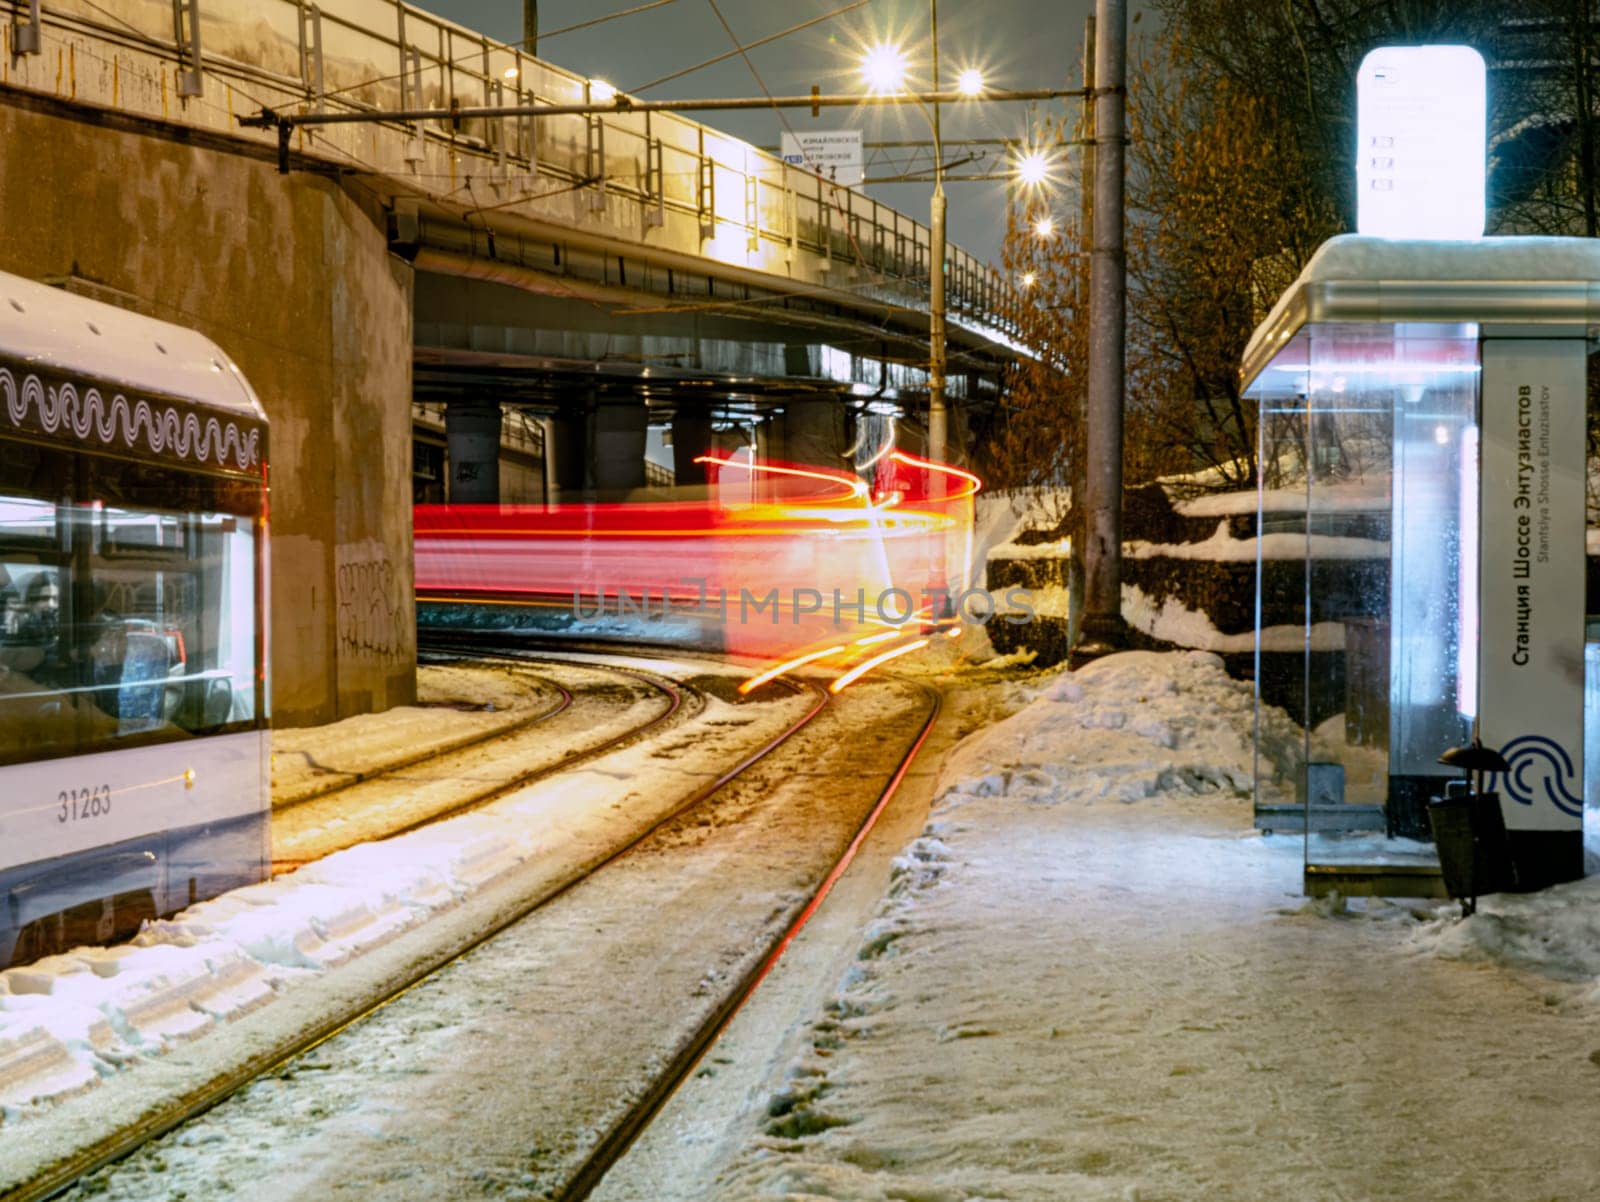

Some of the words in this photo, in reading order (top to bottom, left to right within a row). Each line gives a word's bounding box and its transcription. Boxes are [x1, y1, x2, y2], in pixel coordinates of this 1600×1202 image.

[1513, 384, 1535, 510] Энтузиастов
[1537, 385, 1550, 458] Entuziastov
[1537, 459, 1550, 505] Shosse
[1513, 515, 1531, 580] Шоссе
[1537, 506, 1552, 564] Stantsiya
[1512, 585, 1532, 667] Станция
[57, 784, 111, 823] 31263
